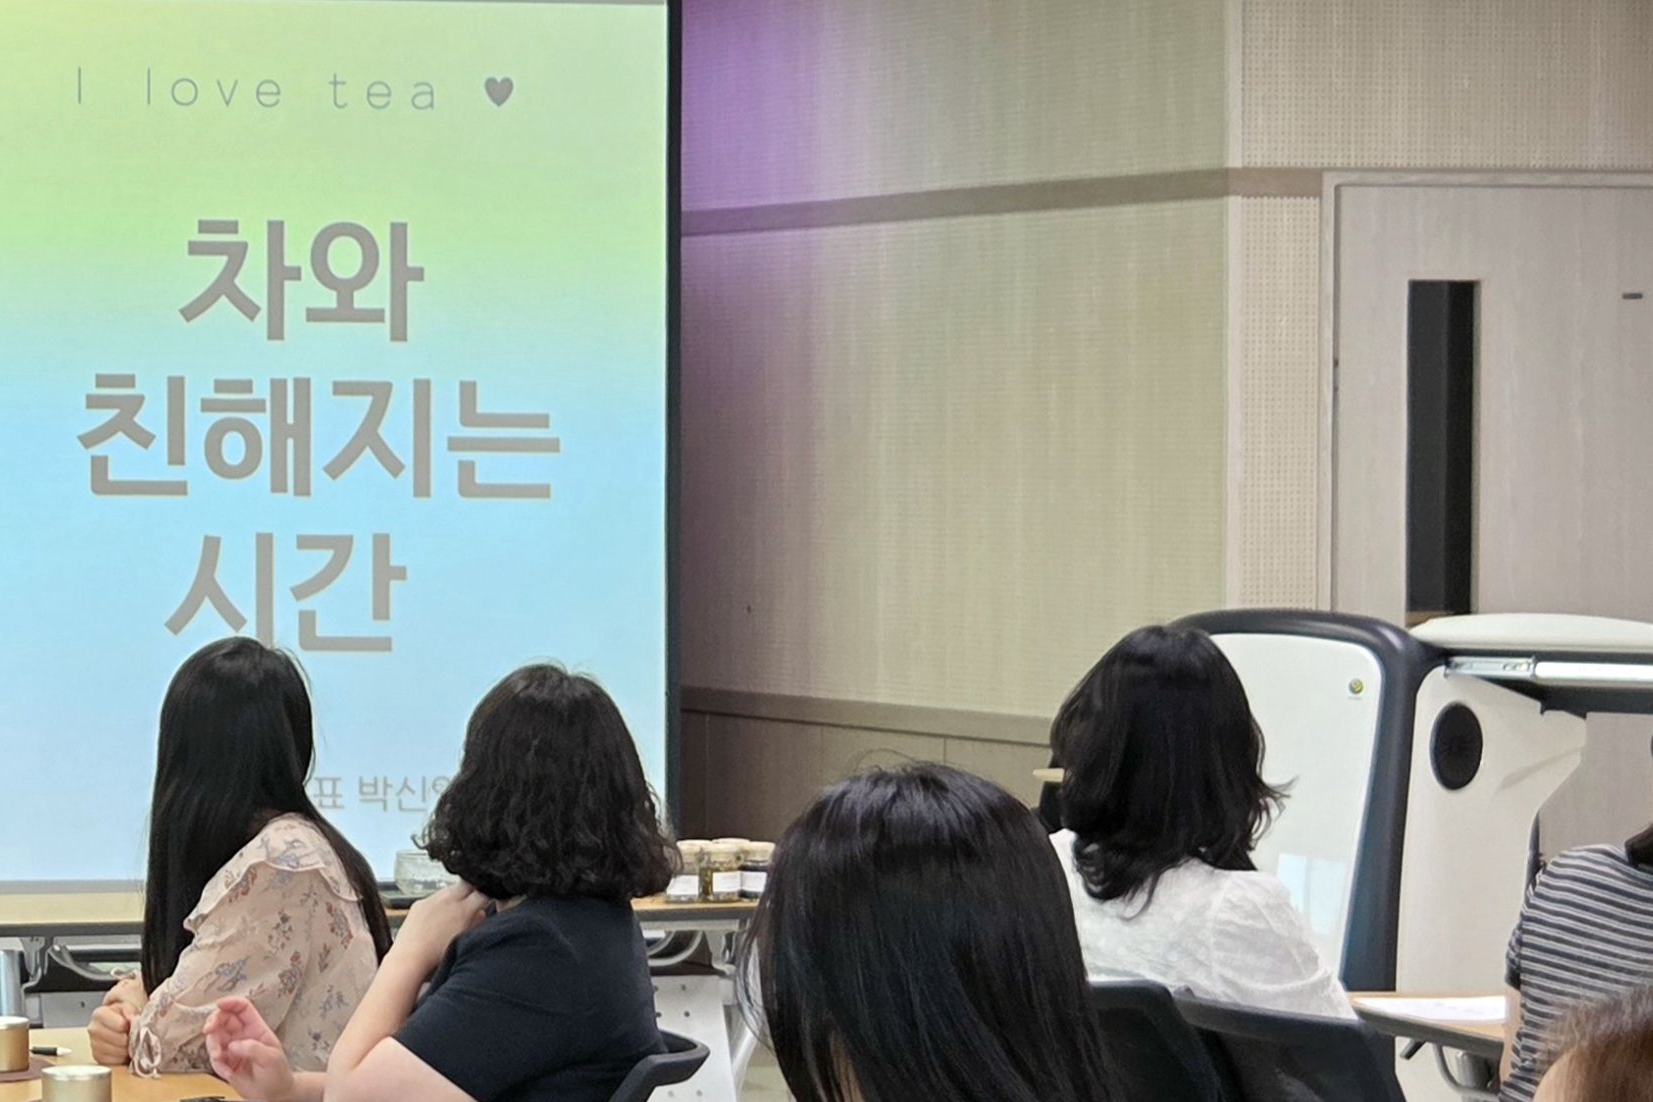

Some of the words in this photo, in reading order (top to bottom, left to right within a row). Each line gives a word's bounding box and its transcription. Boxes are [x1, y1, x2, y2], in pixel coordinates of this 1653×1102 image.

[146, 67, 282, 108] love
[328, 72, 436, 111] tea
[178, 219, 425, 343] 차와
[76, 373, 561, 499] 친해지는
[164, 532, 408, 653] 시간
[313, 776, 345, 810] 표
